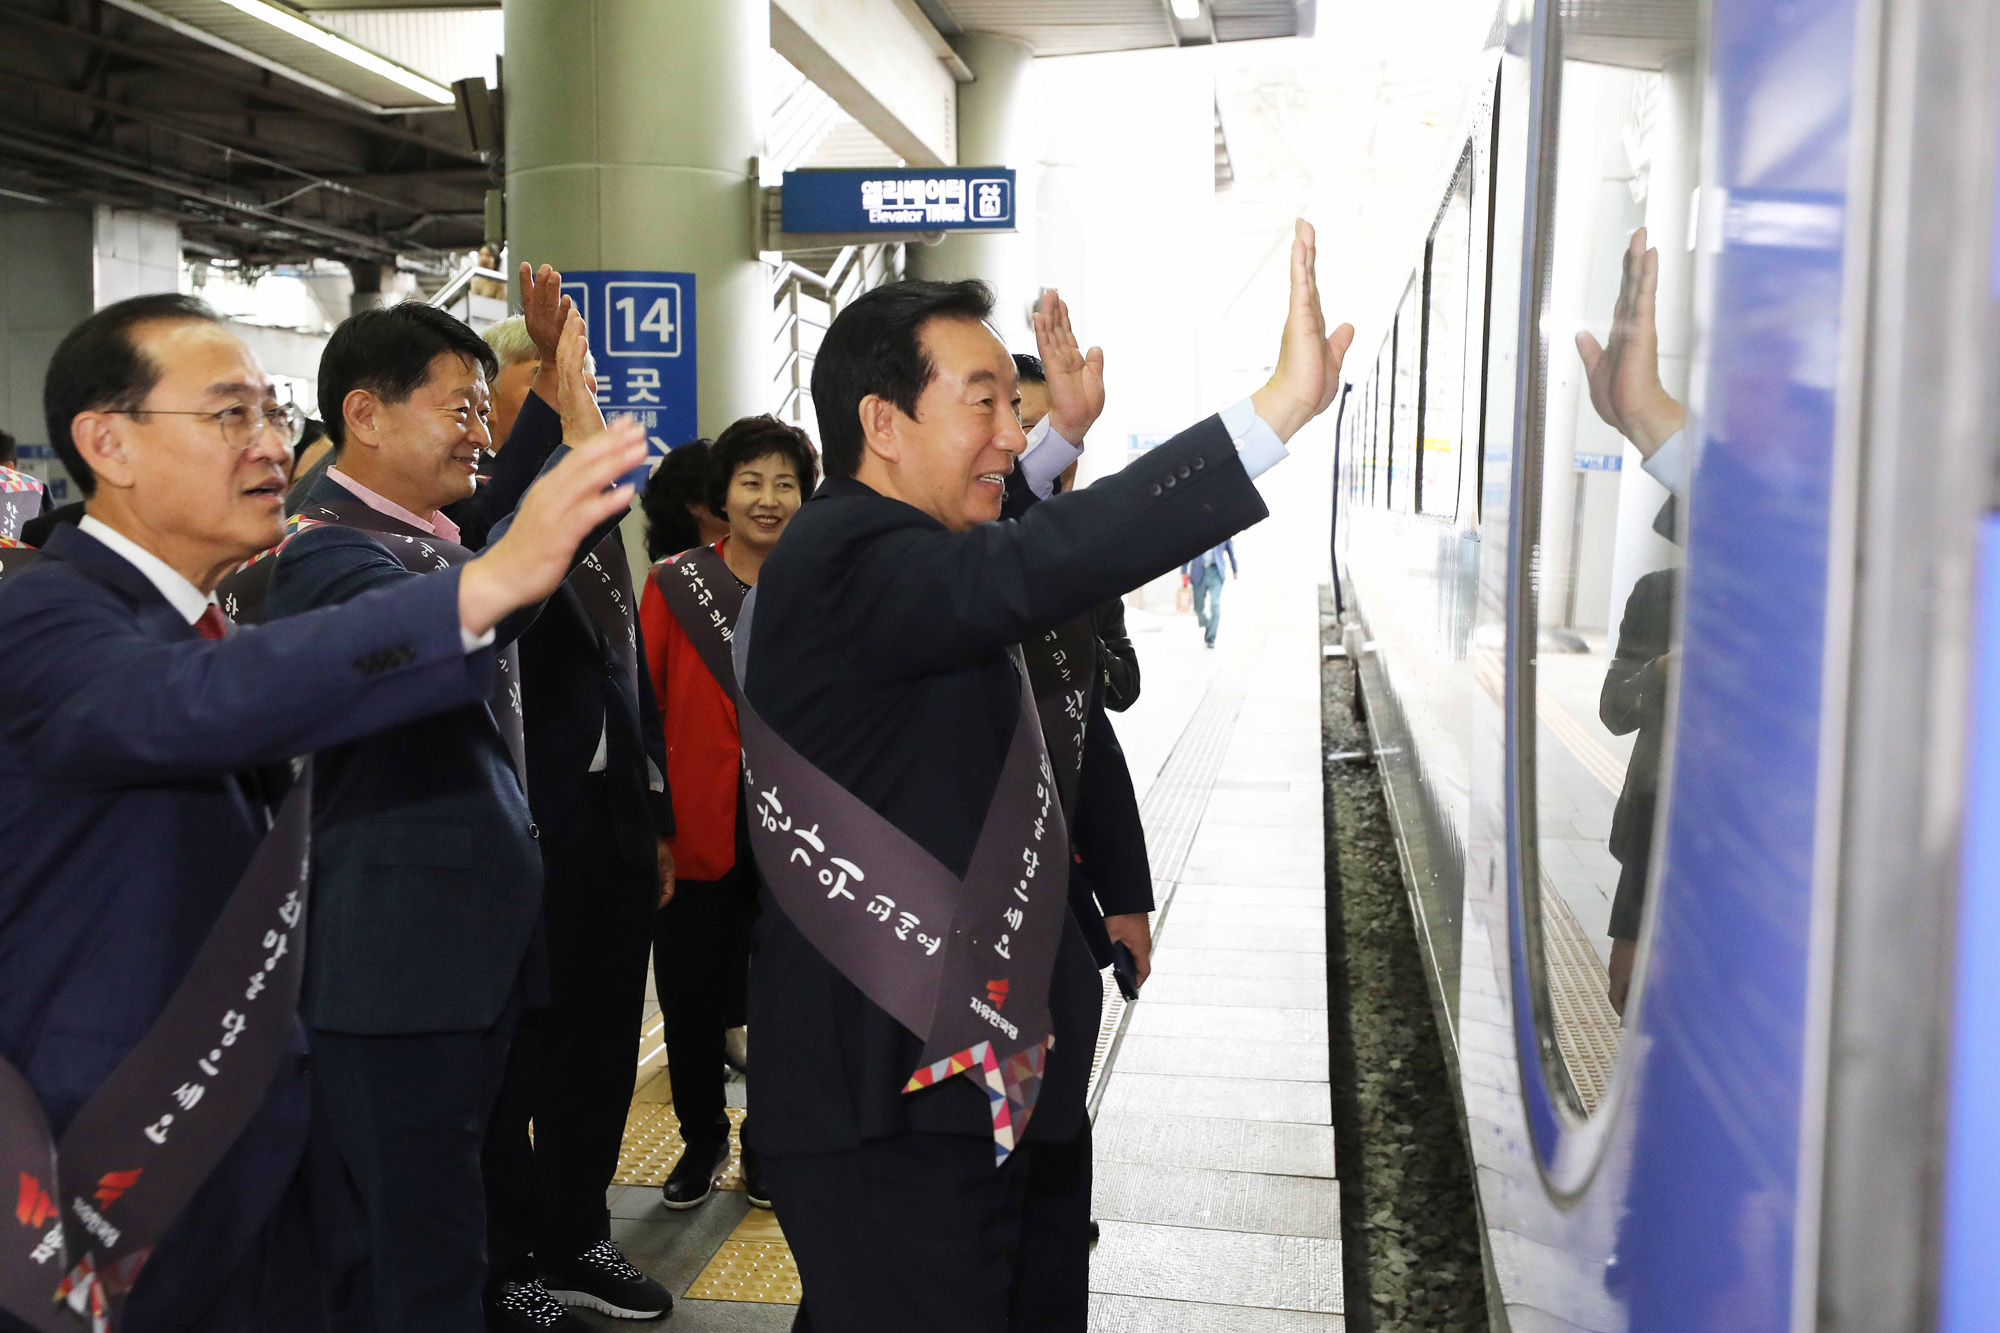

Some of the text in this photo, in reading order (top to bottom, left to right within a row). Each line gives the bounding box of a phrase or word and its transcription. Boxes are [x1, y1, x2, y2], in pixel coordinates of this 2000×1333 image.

[861, 179, 966, 207] 엘리베이터
[869, 208, 923, 223] Elevator
[615, 296, 675, 343] 14
[626, 368, 661, 403] 곳
[680, 562, 713, 607] 한가위
[756, 786, 942, 956] 한가위 되세요
[993, 847, 1040, 960] 담으세요
[969, 996, 1019, 1041] 자유한국당
